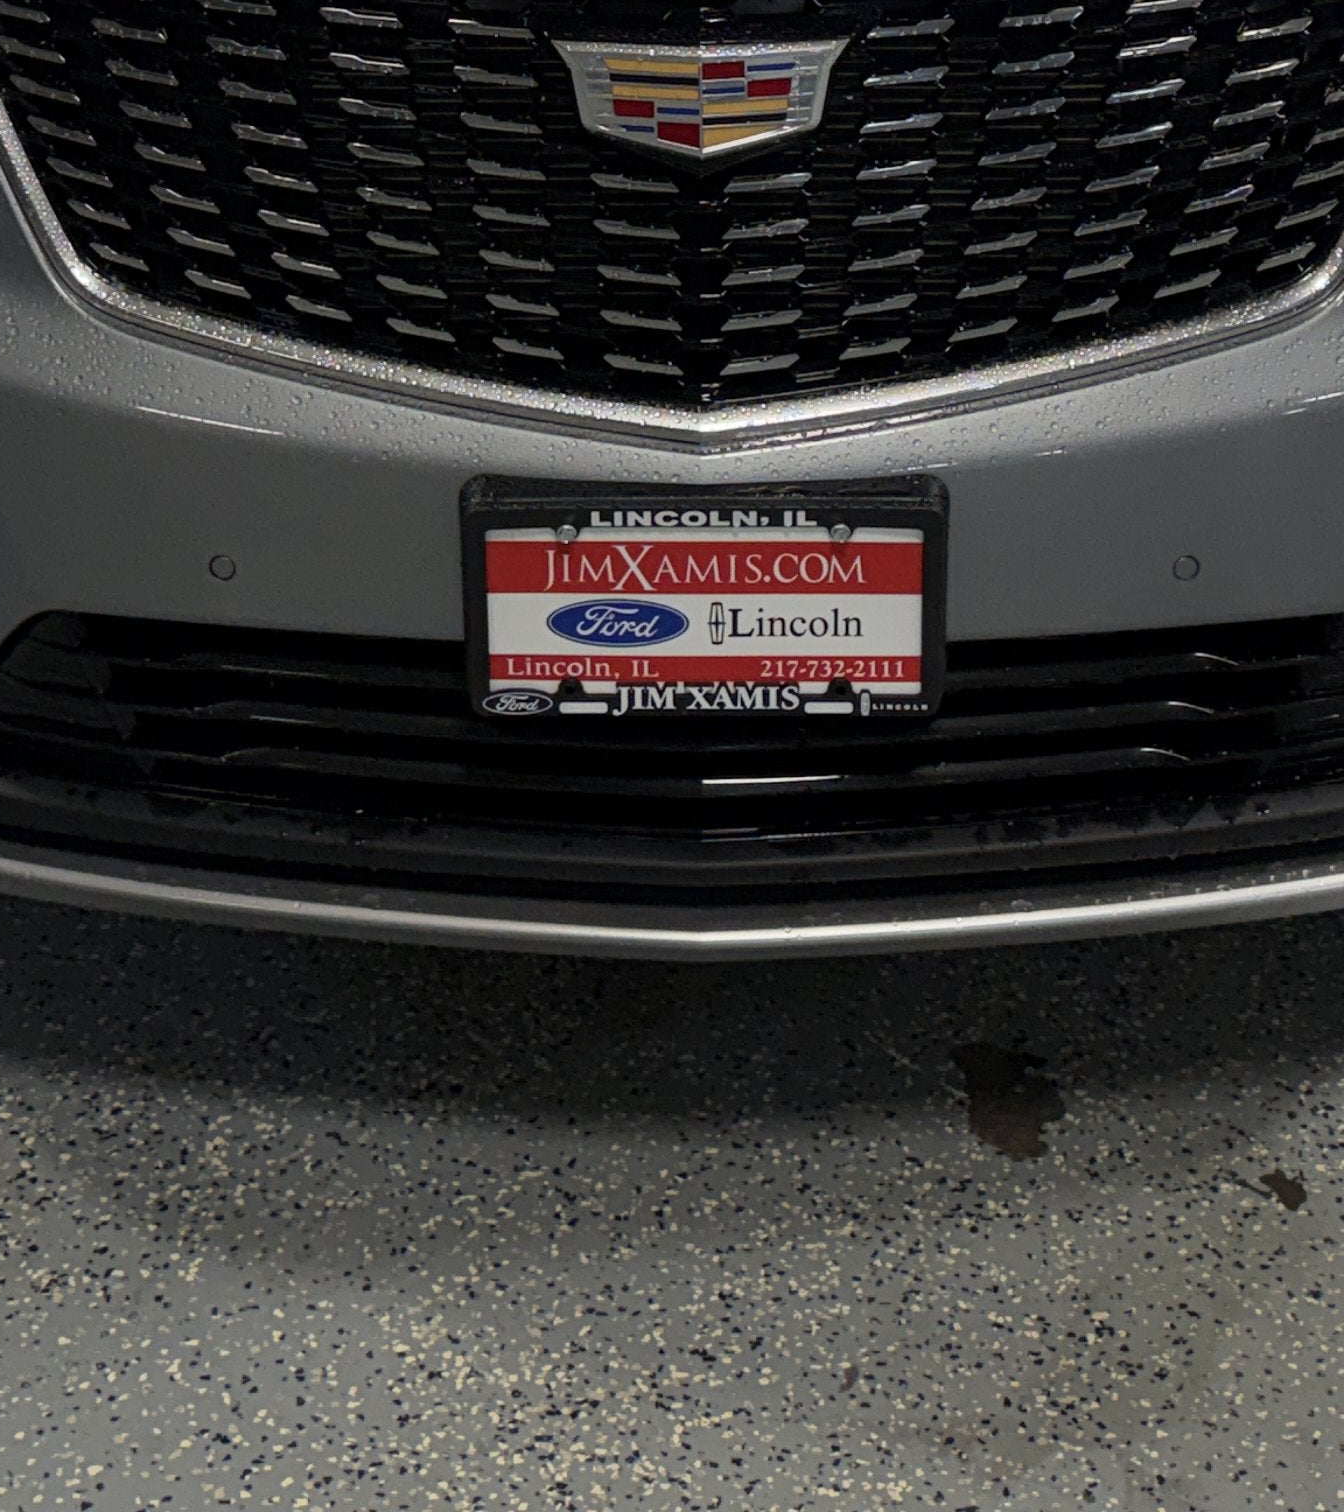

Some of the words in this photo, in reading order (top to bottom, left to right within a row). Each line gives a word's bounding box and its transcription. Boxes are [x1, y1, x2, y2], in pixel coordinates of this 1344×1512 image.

[590, 510, 769, 527] LINCOLN,
[783, 510, 818, 527] IL
[575, 605, 660, 638] Ford
[728, 607, 863, 638] Lincoln
[506, 658, 620, 680] Lincoln,
[632, 659, 660, 678] IL
[760, 659, 904, 678] 217-732-2111
[612, 686, 677, 717] JIM
[686, 685, 801, 711] XAMIS
